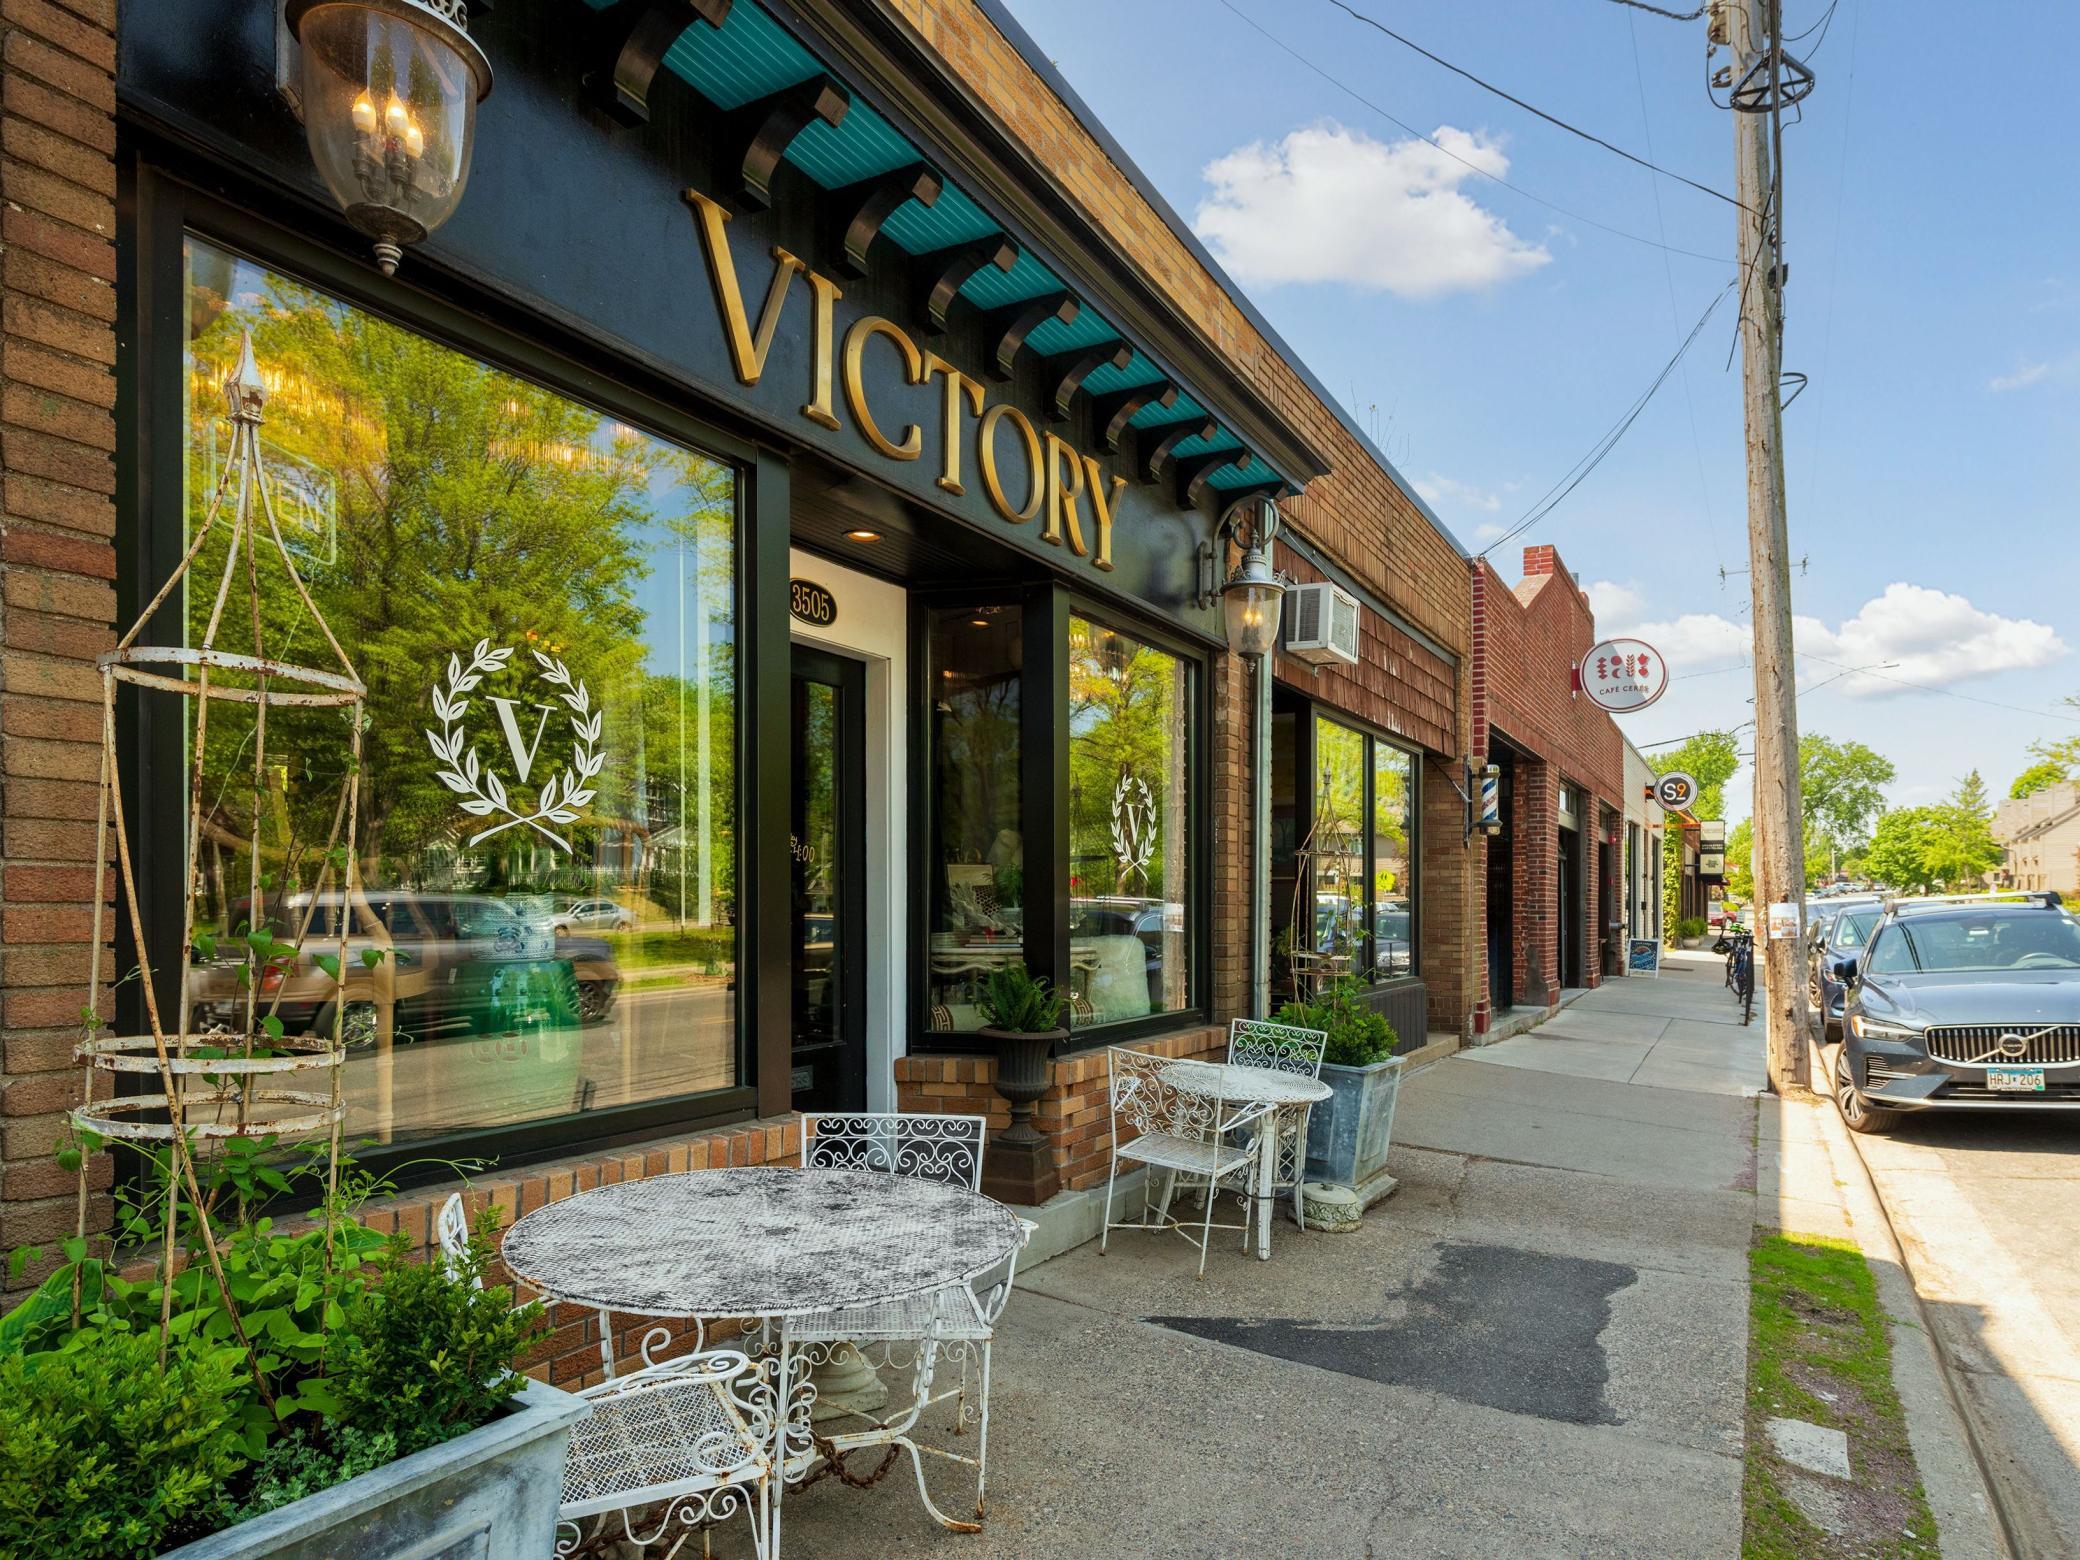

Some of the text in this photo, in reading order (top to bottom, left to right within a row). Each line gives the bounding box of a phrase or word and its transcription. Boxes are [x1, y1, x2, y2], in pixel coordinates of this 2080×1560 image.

[684, 187, 1128, 572] VICTORY
[792, 584, 830, 621] 3505
[485, 695, 558, 783] V
[1125, 802, 1145, 846] V
[1989, 1073, 2041, 1086] HRJ 206
